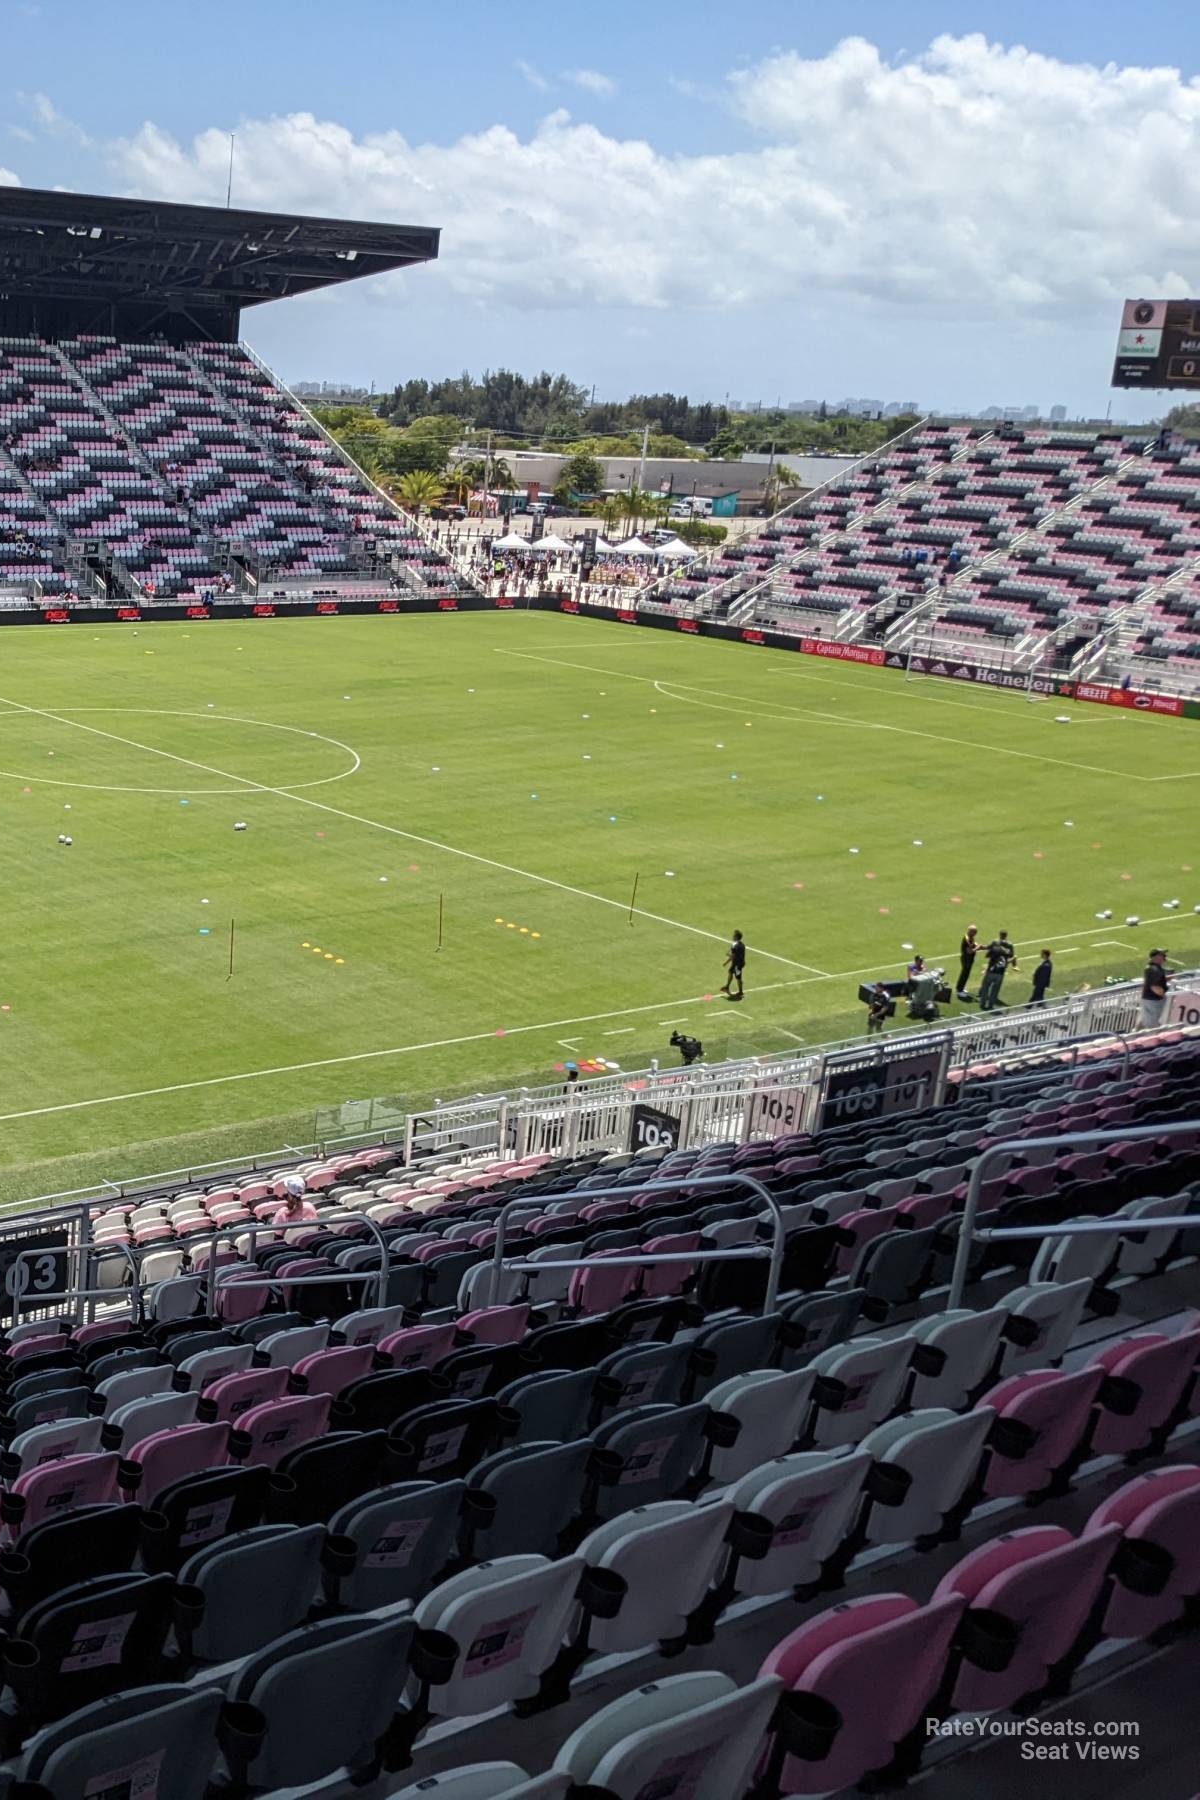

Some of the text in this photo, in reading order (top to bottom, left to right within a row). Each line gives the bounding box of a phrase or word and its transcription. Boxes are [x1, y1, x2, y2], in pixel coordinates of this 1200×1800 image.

[45, 611, 68, 619] DEX
[975, 668, 1054, 693] Heineken
[761, 1095, 794, 1126] 102
[833, 1082, 879, 1117] 103
